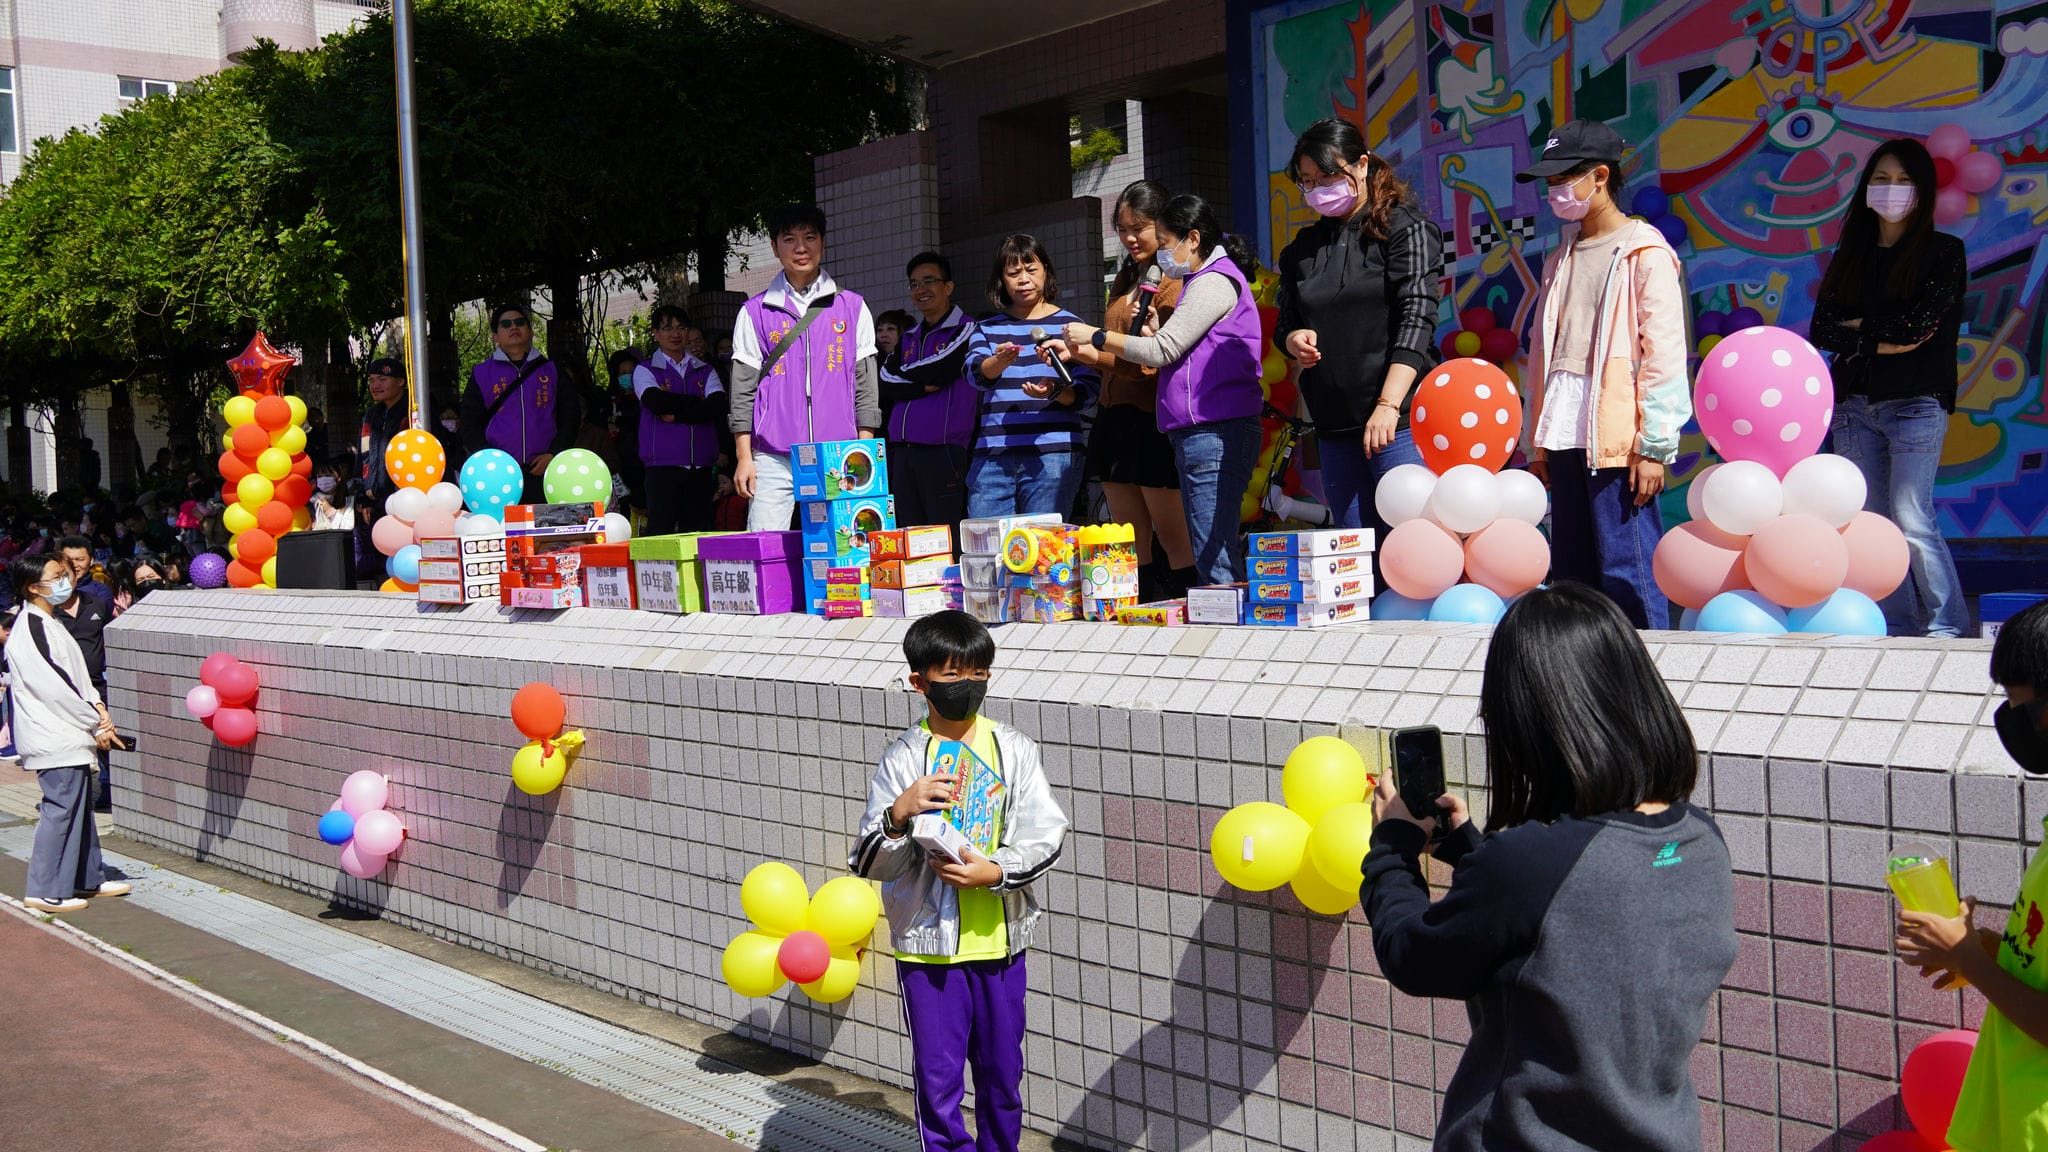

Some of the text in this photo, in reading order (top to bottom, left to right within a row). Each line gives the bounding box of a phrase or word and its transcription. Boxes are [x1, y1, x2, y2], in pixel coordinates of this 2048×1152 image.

[598, 583, 619, 596] 低年級
[641, 570, 674, 592] 中年級
[711, 571, 750, 593] 高年級
